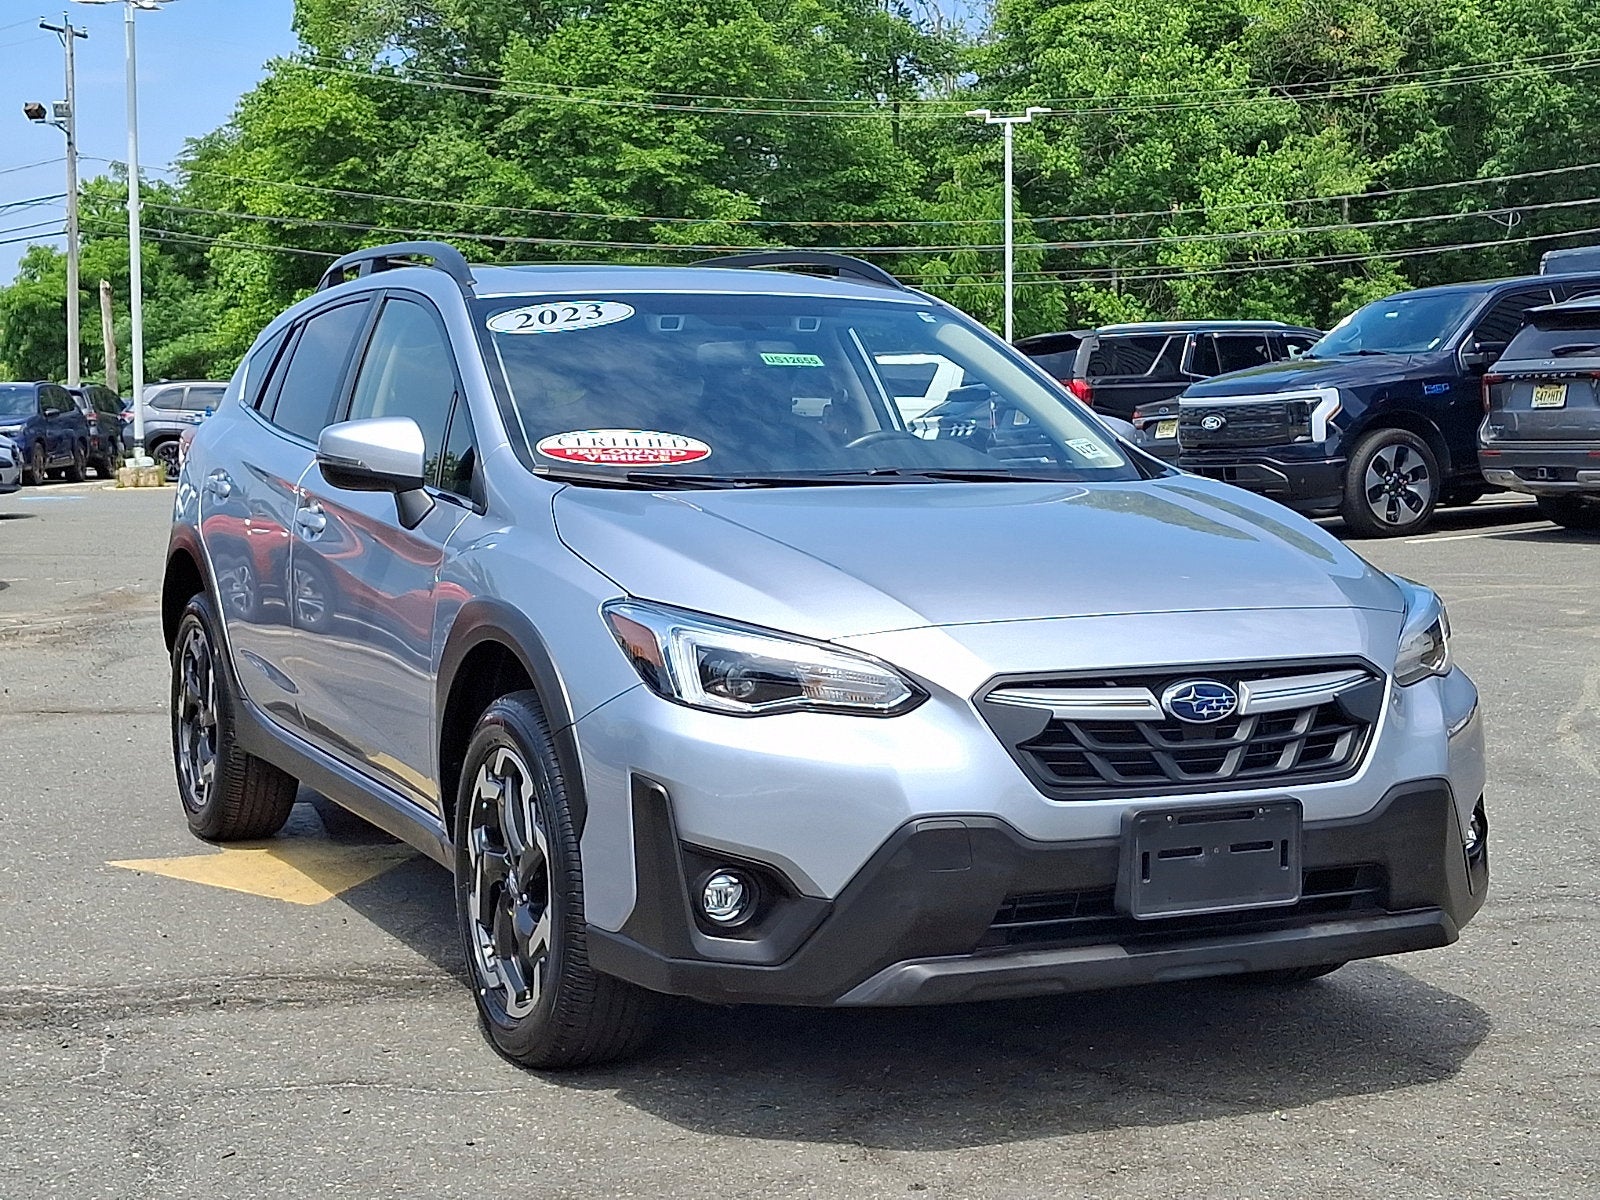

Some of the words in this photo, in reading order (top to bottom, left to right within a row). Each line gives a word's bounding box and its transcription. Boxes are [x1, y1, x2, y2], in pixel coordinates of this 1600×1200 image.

[514, 304, 603, 330] 2023
[565, 448, 687, 457] PRE-OWNED
[584, 454, 671, 462] VEHICLE
